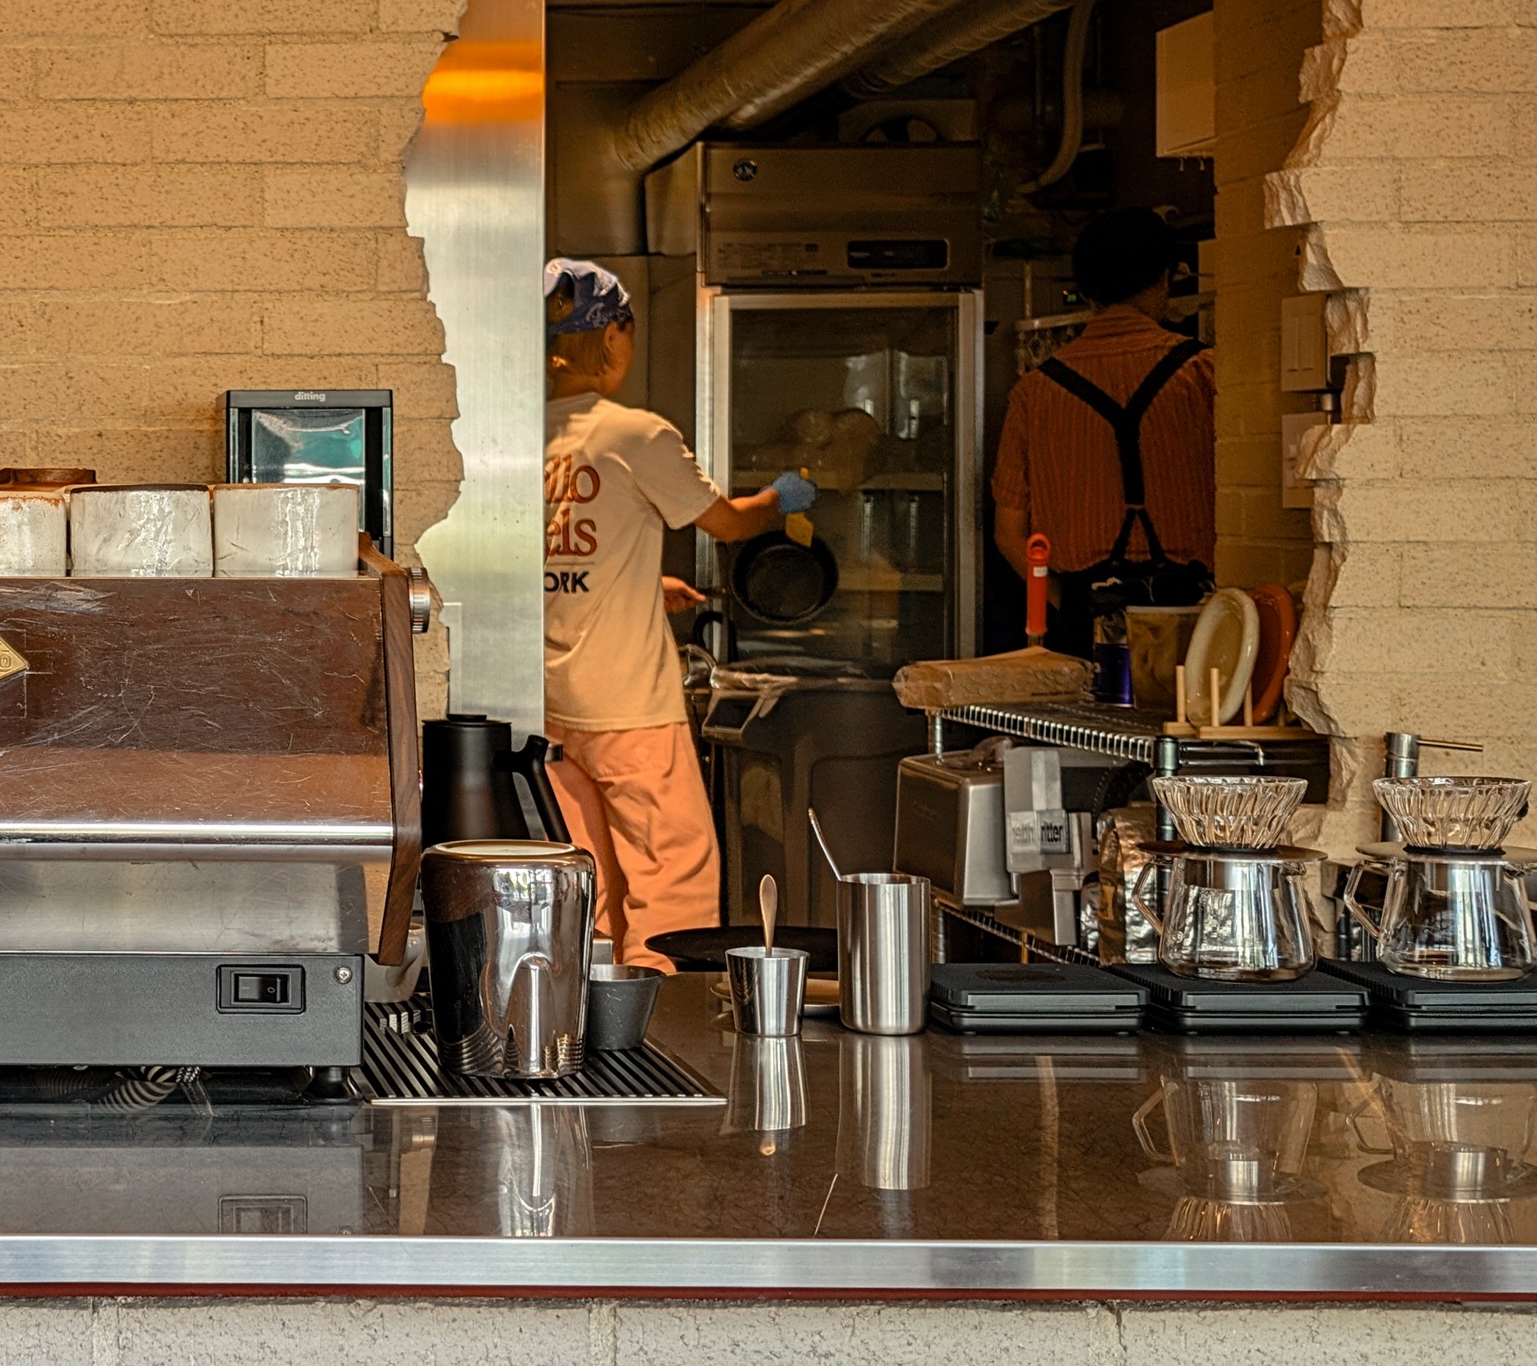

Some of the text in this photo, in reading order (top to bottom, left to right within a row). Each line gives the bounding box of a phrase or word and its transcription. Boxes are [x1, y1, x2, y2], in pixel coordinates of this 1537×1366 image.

[294, 391, 326, 403] ditting
[545, 508, 598, 557] els
[544, 571, 589, 594] ORK
[1041, 821, 1064, 843] ritter
